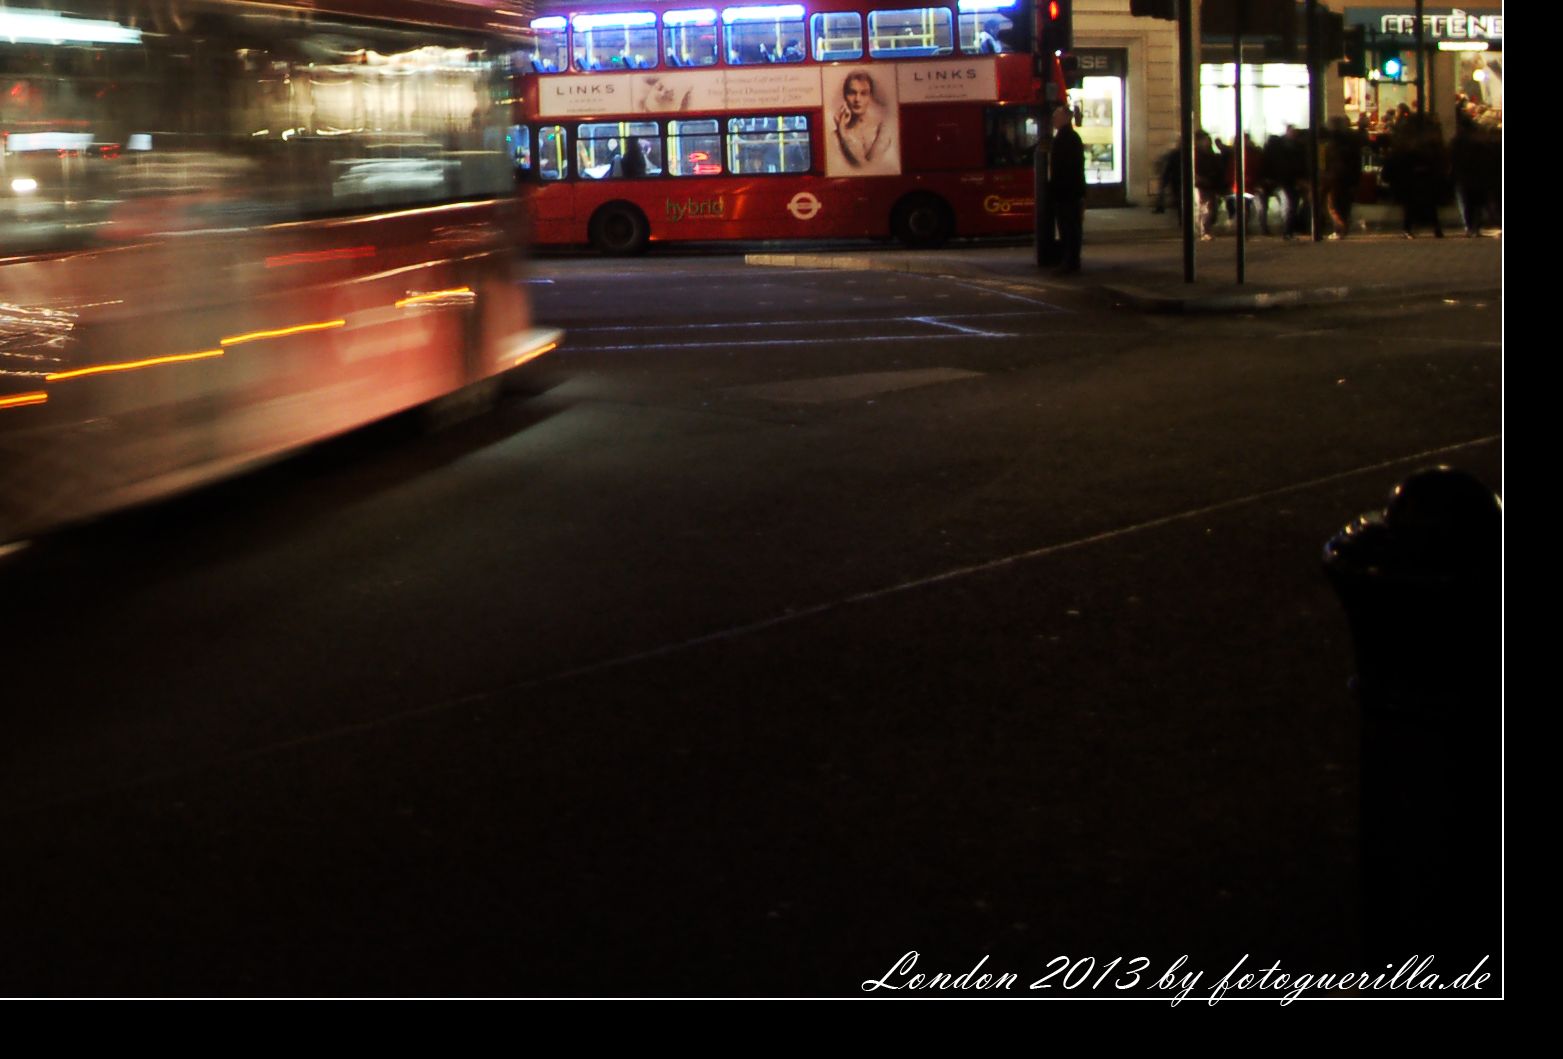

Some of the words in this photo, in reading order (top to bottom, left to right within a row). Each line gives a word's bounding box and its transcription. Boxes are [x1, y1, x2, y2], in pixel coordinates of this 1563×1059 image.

[913, 69, 977, 81] LINKS
[556, 84, 615, 95] LINKS
[666, 195, 724, 222] hybrid
[984, 194, 1011, 213] Go
